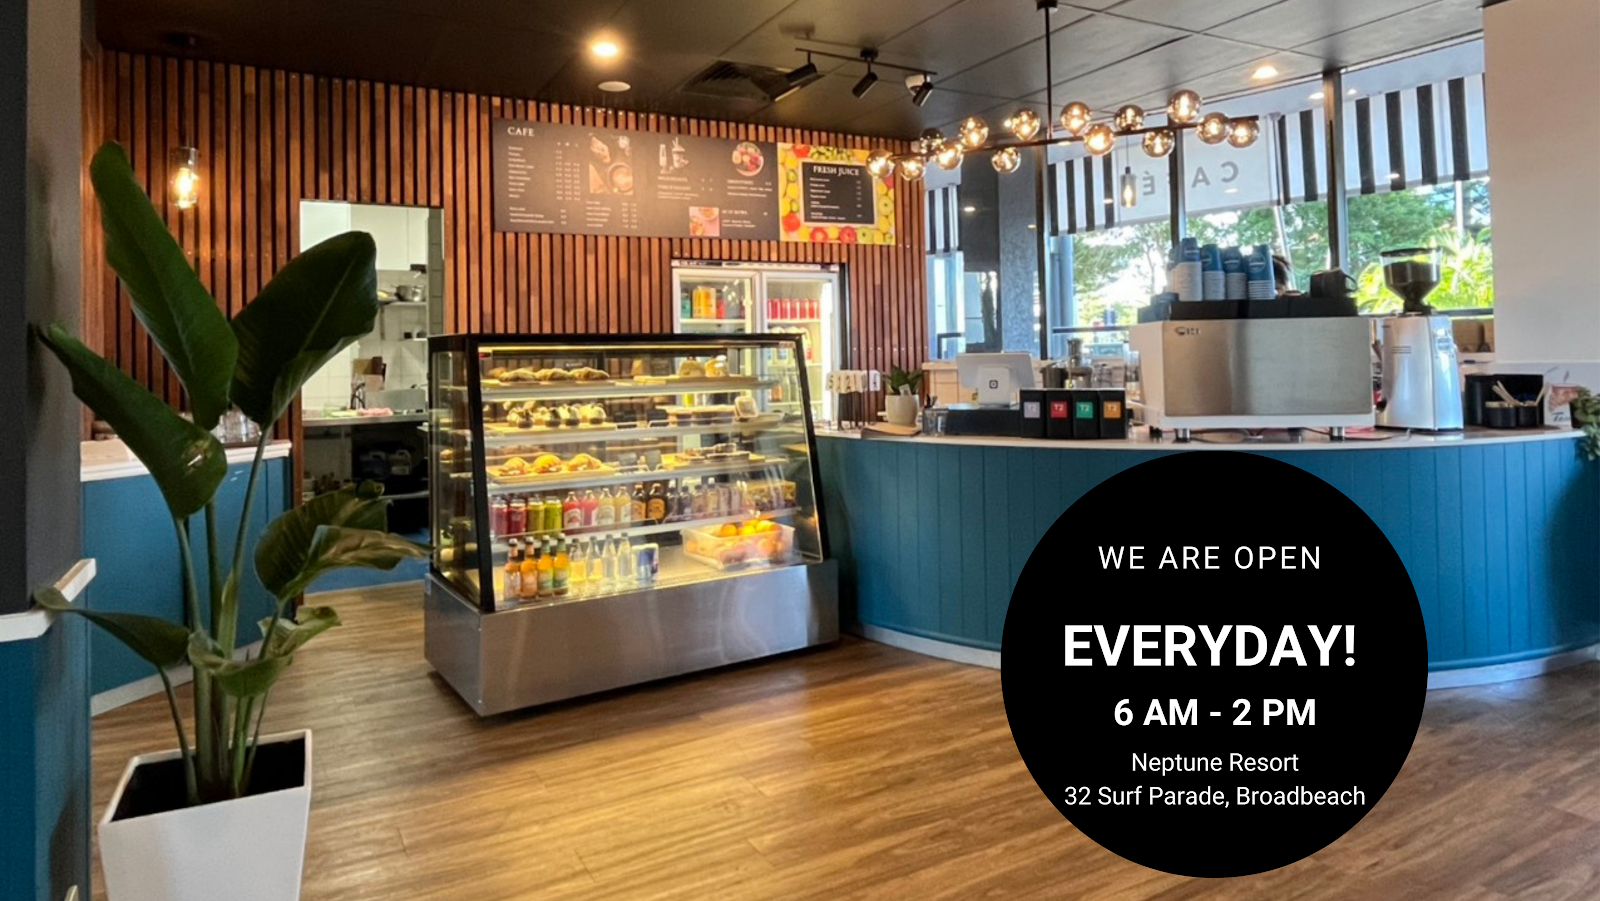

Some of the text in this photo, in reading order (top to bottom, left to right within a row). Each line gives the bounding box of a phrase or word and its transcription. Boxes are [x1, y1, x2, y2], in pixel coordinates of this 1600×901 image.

[507, 126, 535, 137] CAFE
[813, 165, 860, 177] FRESH JUICE
